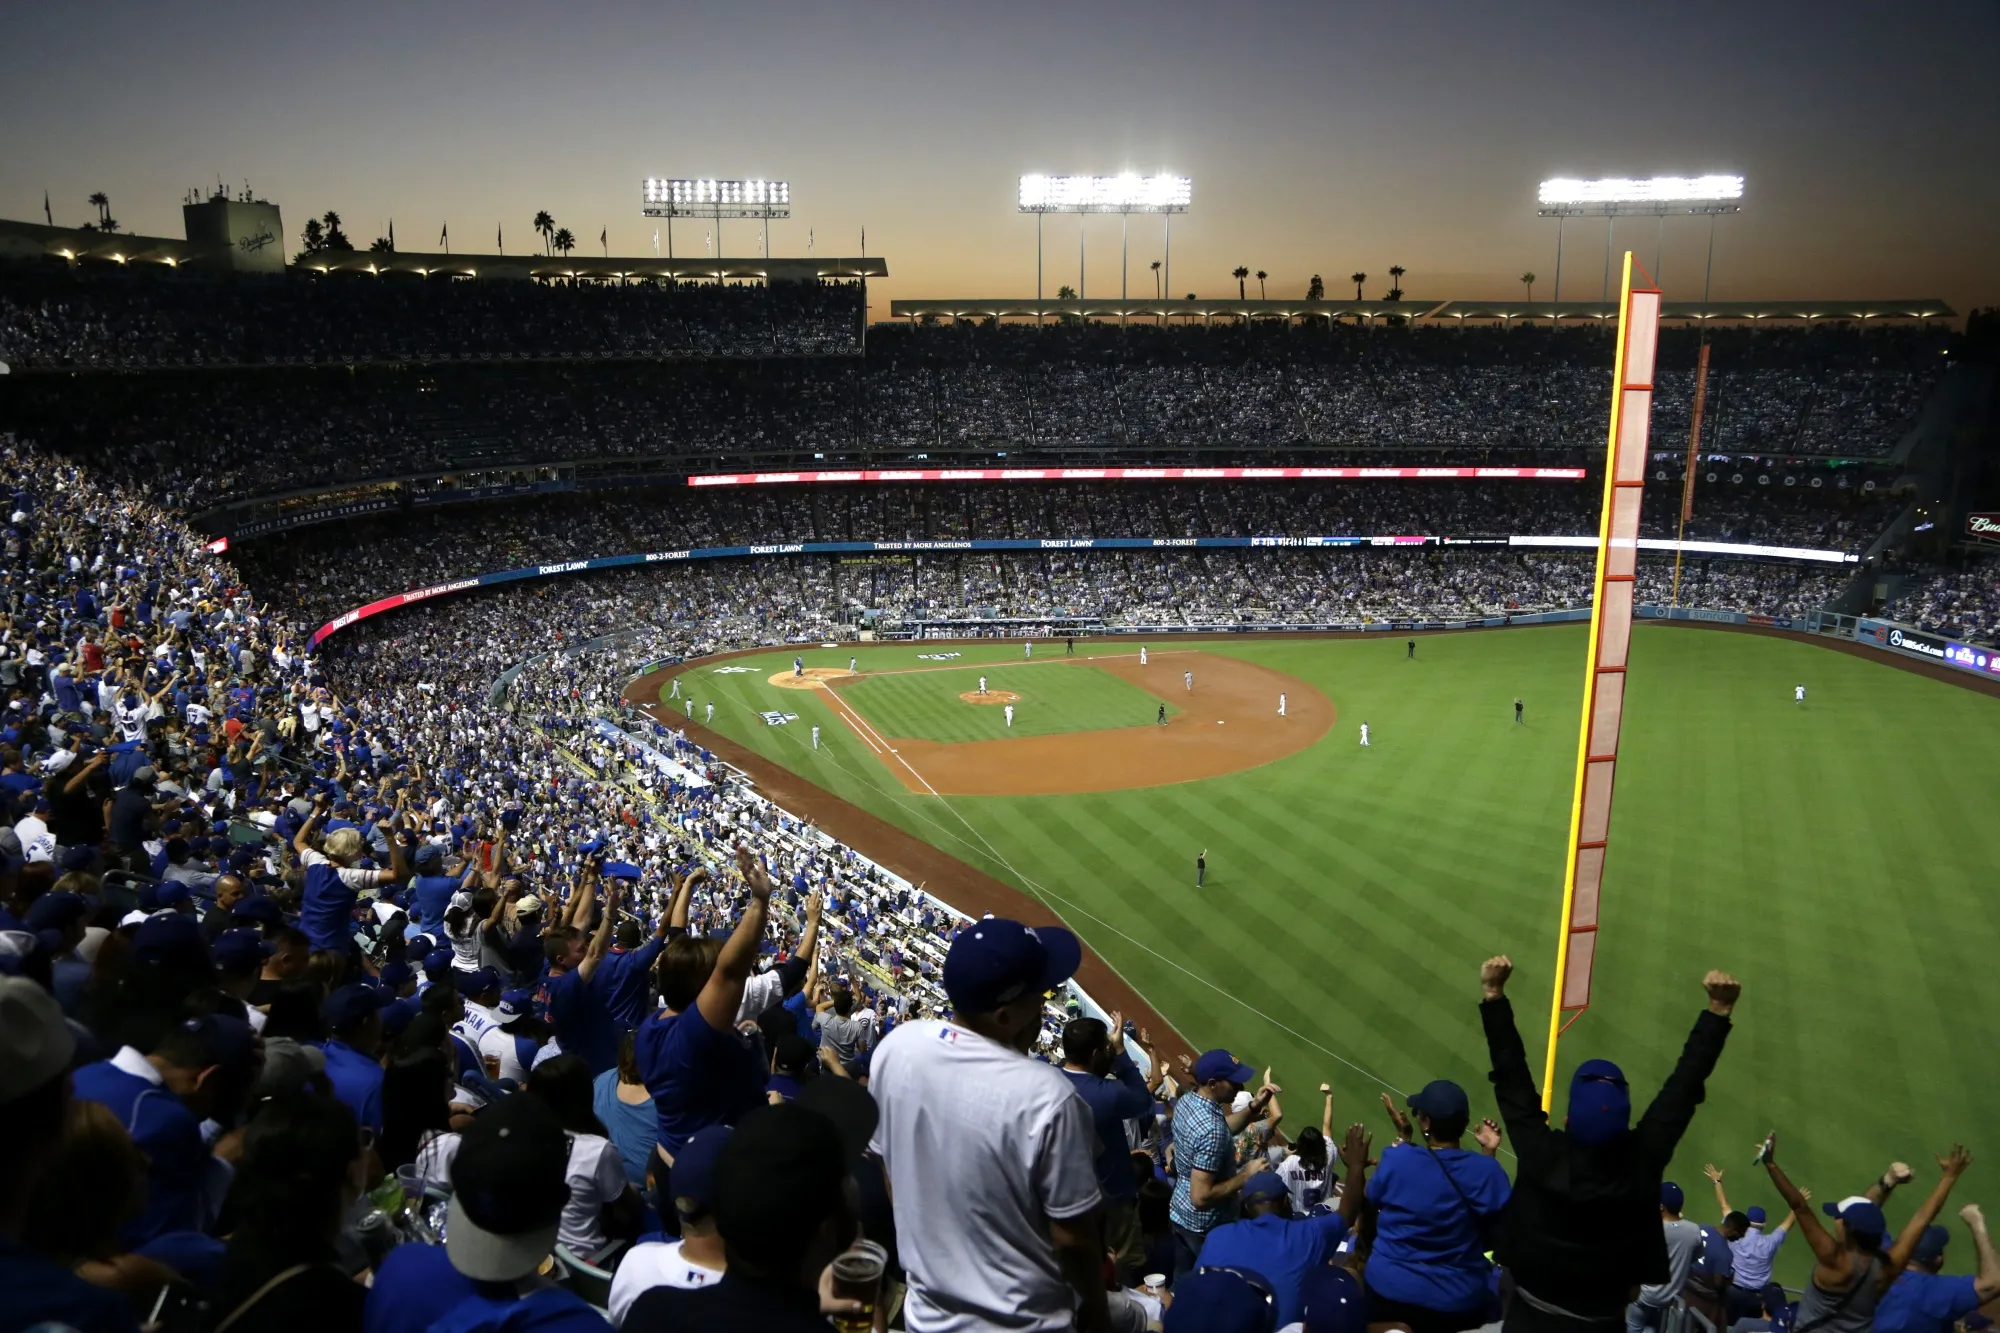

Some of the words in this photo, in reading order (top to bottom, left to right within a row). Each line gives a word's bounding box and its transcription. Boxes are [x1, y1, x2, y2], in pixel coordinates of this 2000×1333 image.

[292, 509, 333, 523] DODGER
[338, 502, 387, 514] STADIUM
[913, 541, 933, 549] MORE
[933, 541, 972, 549] ANGELENOS
[1040, 539, 1068, 548] FOREST
[1152, 538, 1198, 546] 800-2-FOREST
[750, 545, 778, 554] FOREST
[645, 550, 691, 561] 800-2-FOREST
[539, 564, 565, 575] FOREST
[402, 590, 425, 602] TRUSTED
[425, 588, 432, 597] BY
[432, 585, 447, 595] MORE
[447, 578, 479, 591] ANGELENOS
[1693, 611, 1731, 622] sunrun
